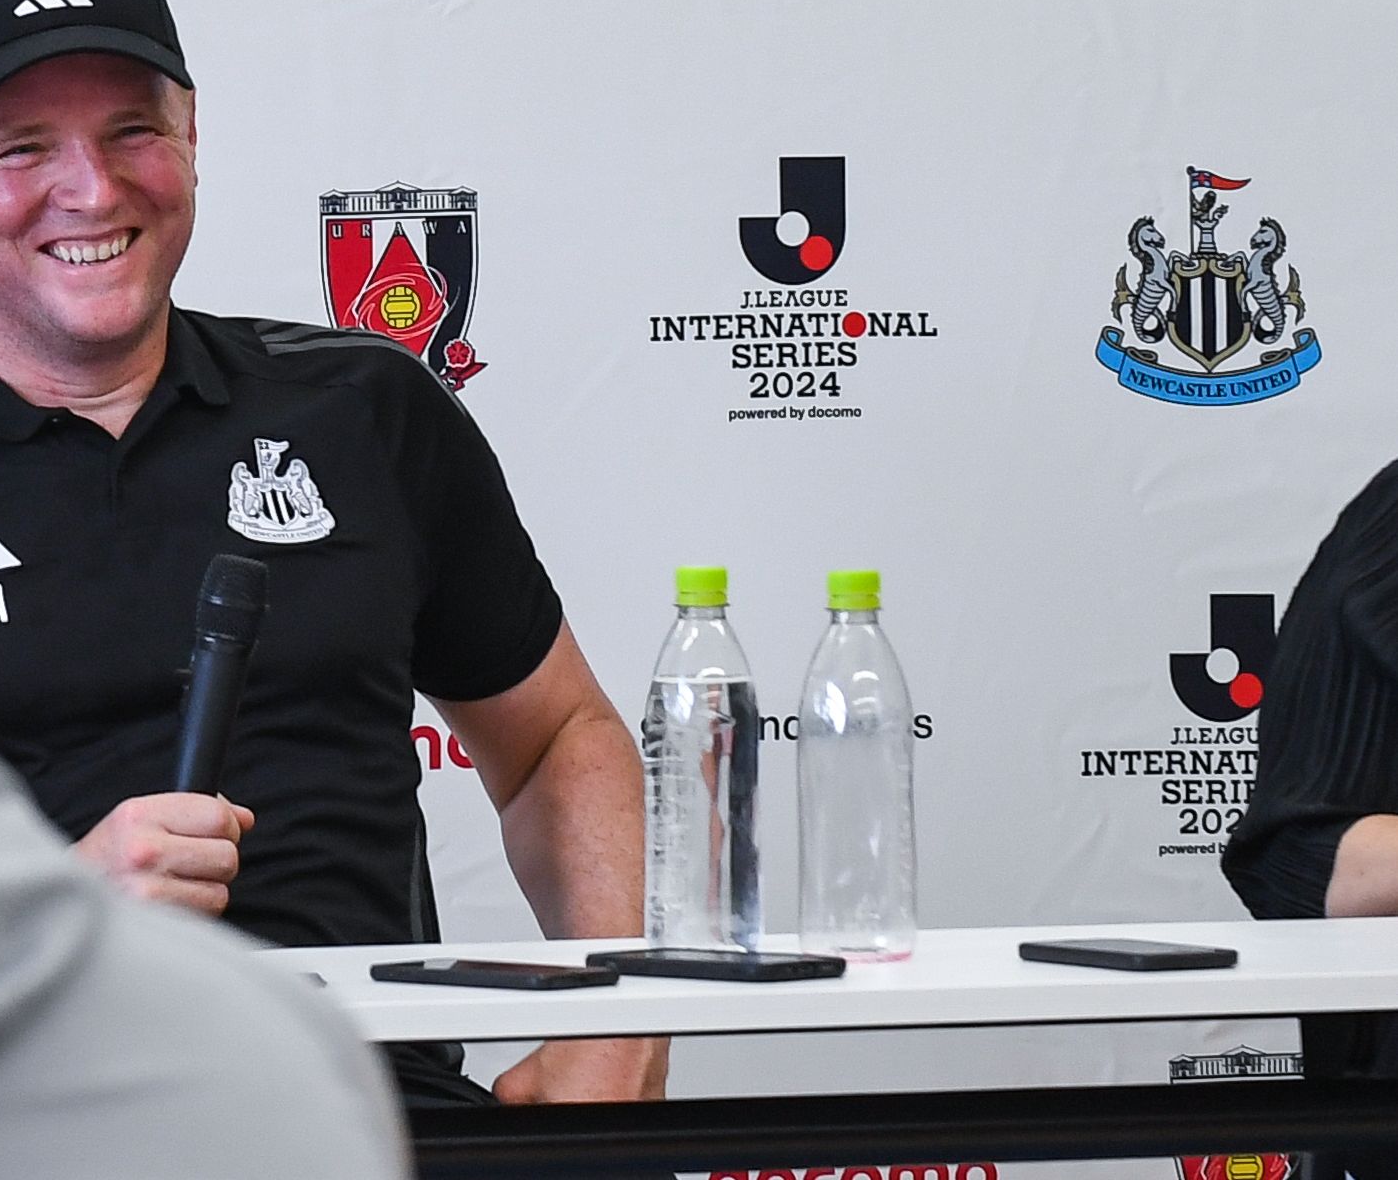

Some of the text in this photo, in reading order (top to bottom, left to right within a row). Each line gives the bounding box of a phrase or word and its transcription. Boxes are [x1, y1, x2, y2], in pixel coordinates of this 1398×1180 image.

[740, 289, 849, 309] J.LEAGUE
[650, 311, 938, 342] INTERNATIONAL
[732, 342, 858, 369] SERIES
[749, 371, 842, 399] 2024
[1126, 367, 1293, 399] NEWCASTLE UNITED
[728, 406, 862, 423] powered by docomo
[1170, 727, 1259, 745] J.LEAGU
[1081, 750, 1259, 777] INTERNAT
[1179, 808, 1245, 835] 202
[1159, 842, 1216, 857] powered
